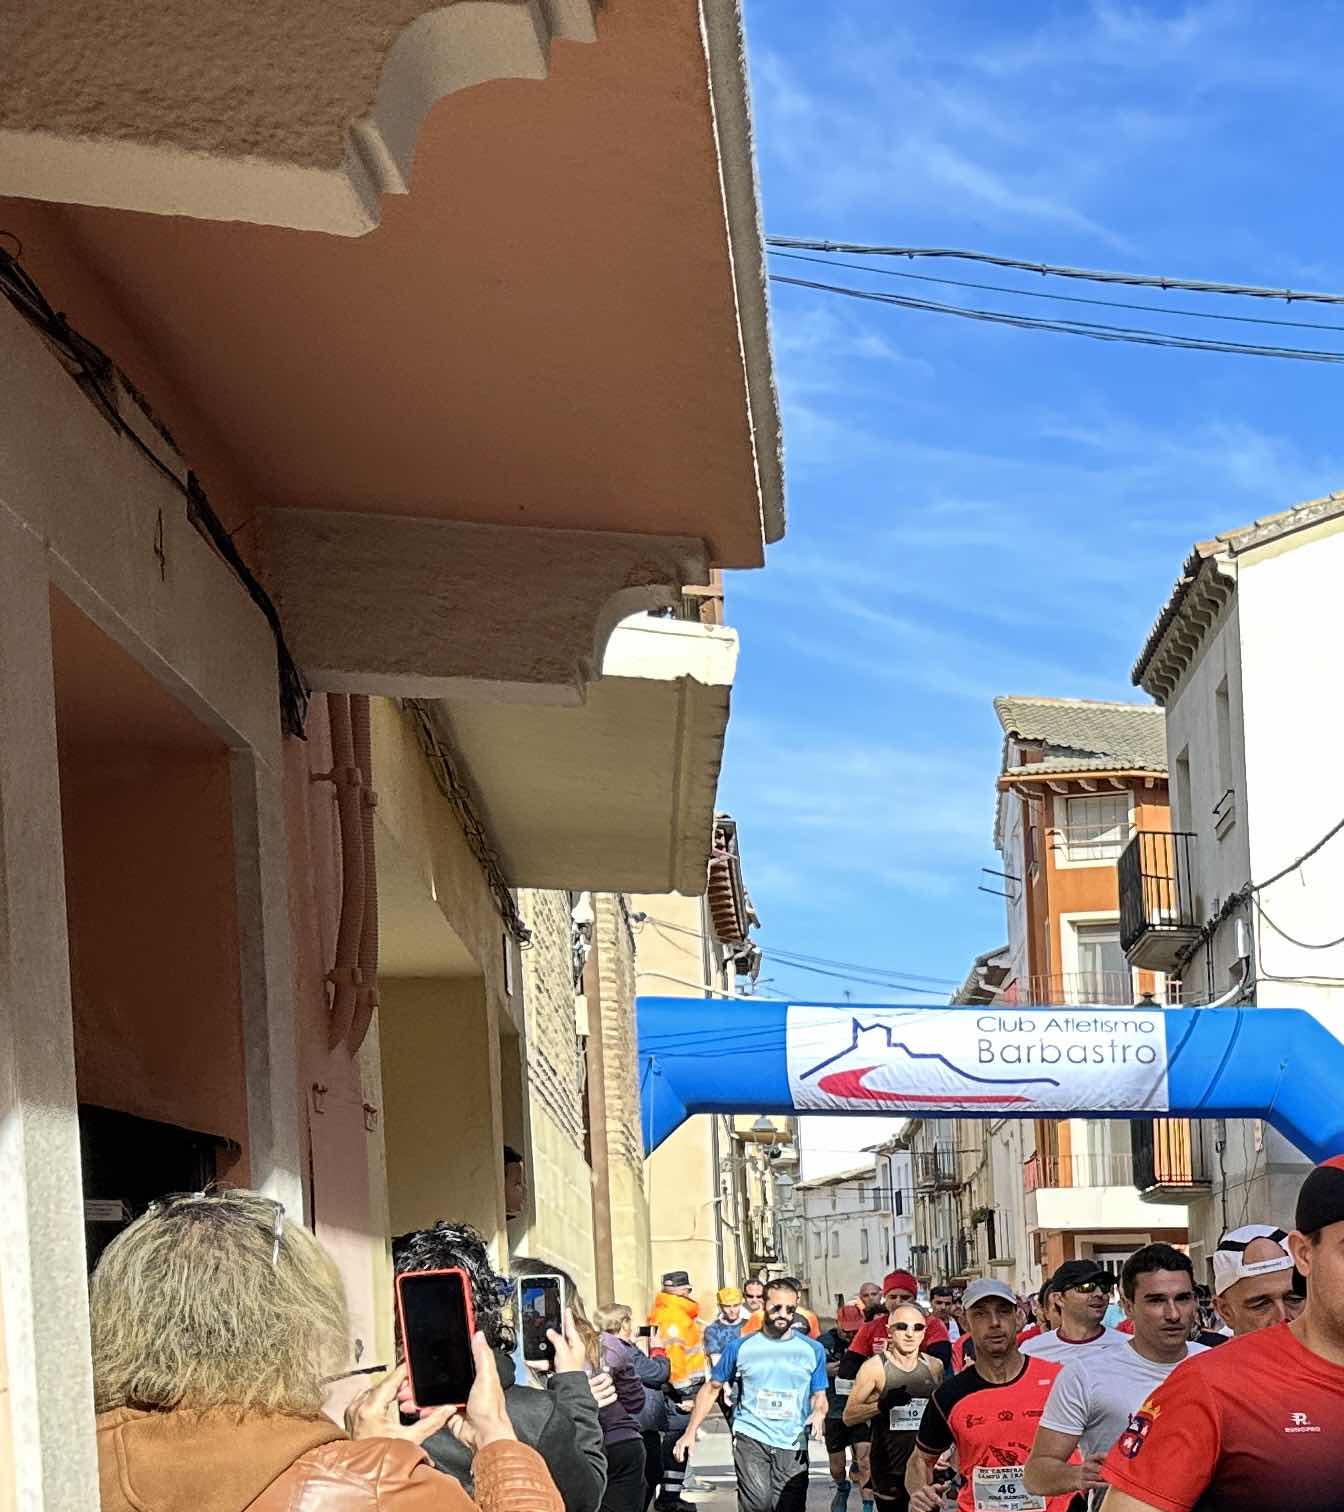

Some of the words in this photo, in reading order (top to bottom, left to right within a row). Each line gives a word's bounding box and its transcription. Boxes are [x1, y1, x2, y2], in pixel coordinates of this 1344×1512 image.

[976, 1016, 1036, 1033] Club
[1043, 1016, 1155, 1034] Atletismo
[978, 1038, 1156, 1064] Barbastro
[997, 1483, 1016, 1494] 46
